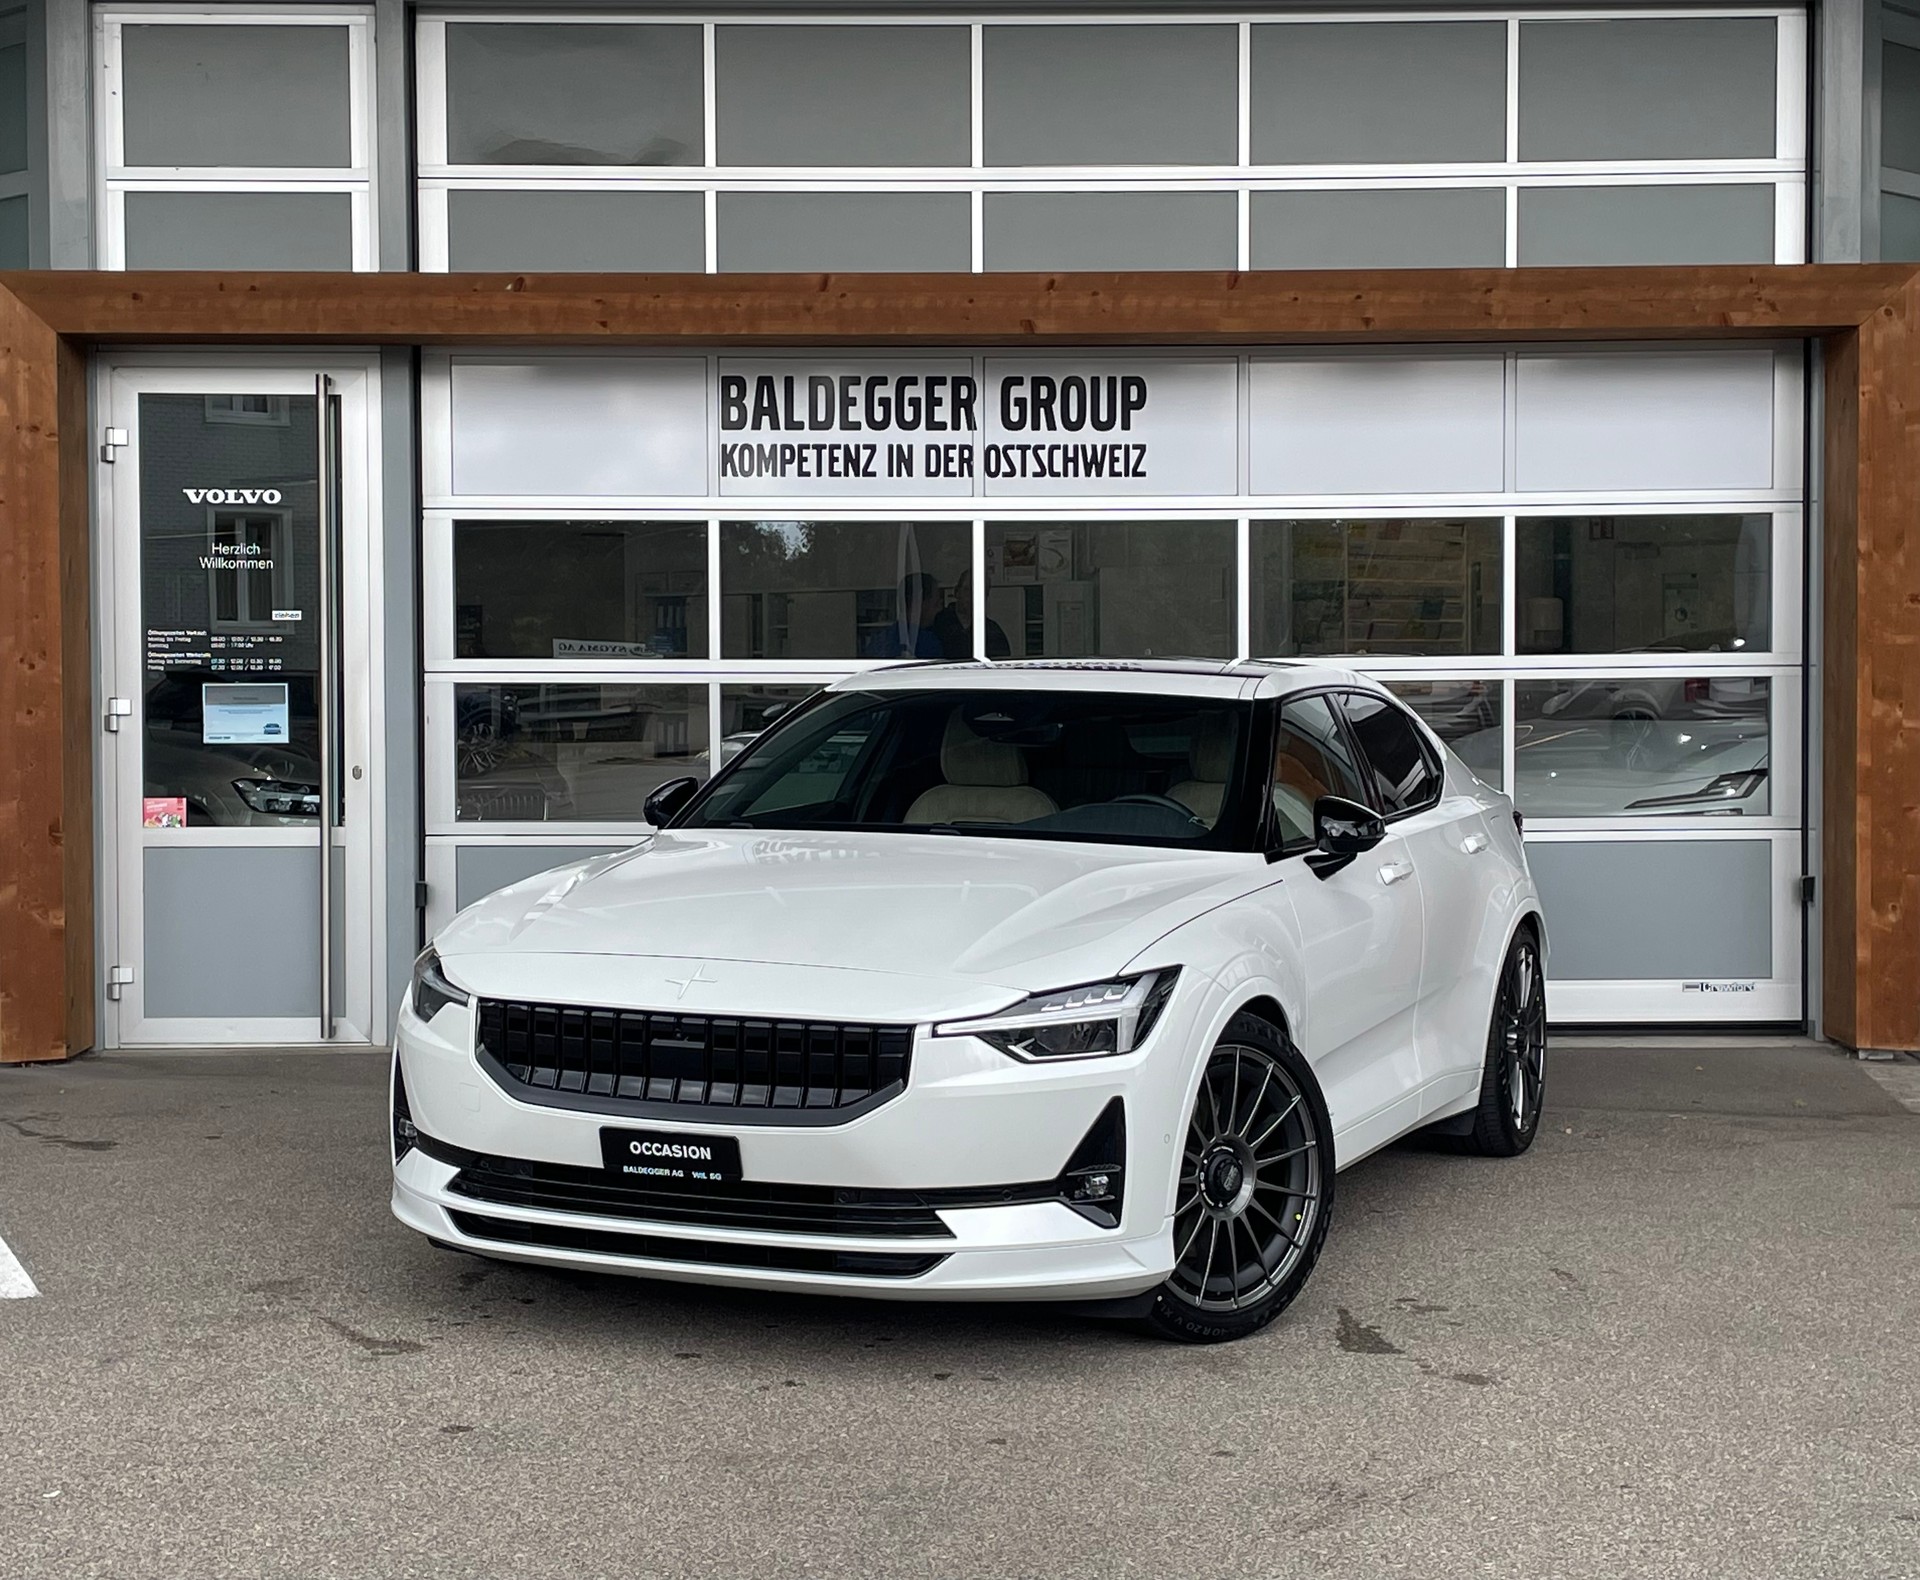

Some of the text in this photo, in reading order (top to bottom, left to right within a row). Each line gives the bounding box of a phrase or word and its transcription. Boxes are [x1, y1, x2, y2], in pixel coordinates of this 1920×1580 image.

[720, 375, 1147, 431] BALDEGGER GROUP
[720, 443, 1147, 478] KOMPETENZ IN DER OSTSCHWEIZ
[183, 488, 282, 504] VOLVO
[211, 542, 260, 555] Herzlich
[199, 556, 274, 569] Willkommen
[629, 1140, 712, 1160] OCCASION
[622, 1165, 671, 1177] BALDEGGER
[671, 1169, 685, 1178] AG
